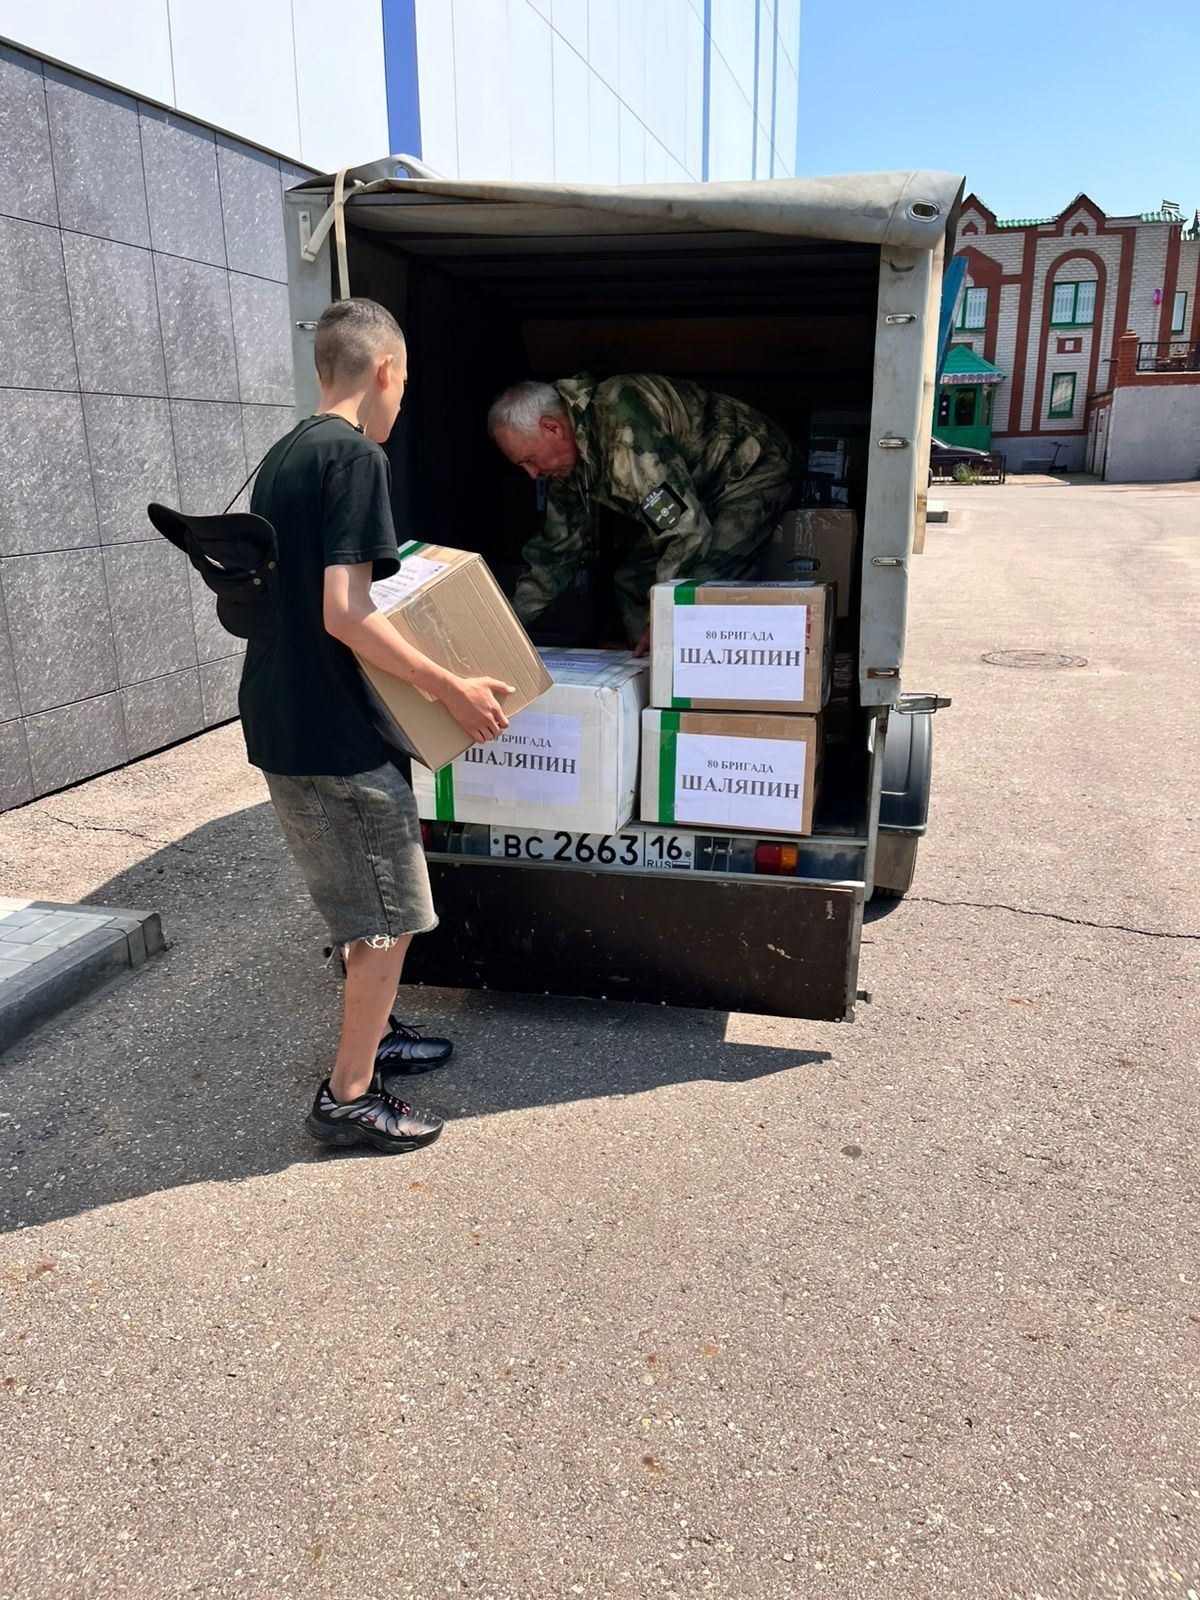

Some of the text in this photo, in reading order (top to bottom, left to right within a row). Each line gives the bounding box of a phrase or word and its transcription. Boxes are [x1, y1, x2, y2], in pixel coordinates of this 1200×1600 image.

[705, 630, 774, 642] 80 БРИГАДА
[680, 648, 801, 667] ШАЛЯПИН
[501, 734, 552, 748] БРИГАДА
[464, 747, 577, 774] ШАЛЯПИН
[707, 759, 774, 774] 80 БРИГАДА
[681, 774, 801, 799] ШАЛЯПИН
[553, 831, 639, 866] 2663
[650, 835, 682, 860] 16
[647, 860, 672, 869] RUS
